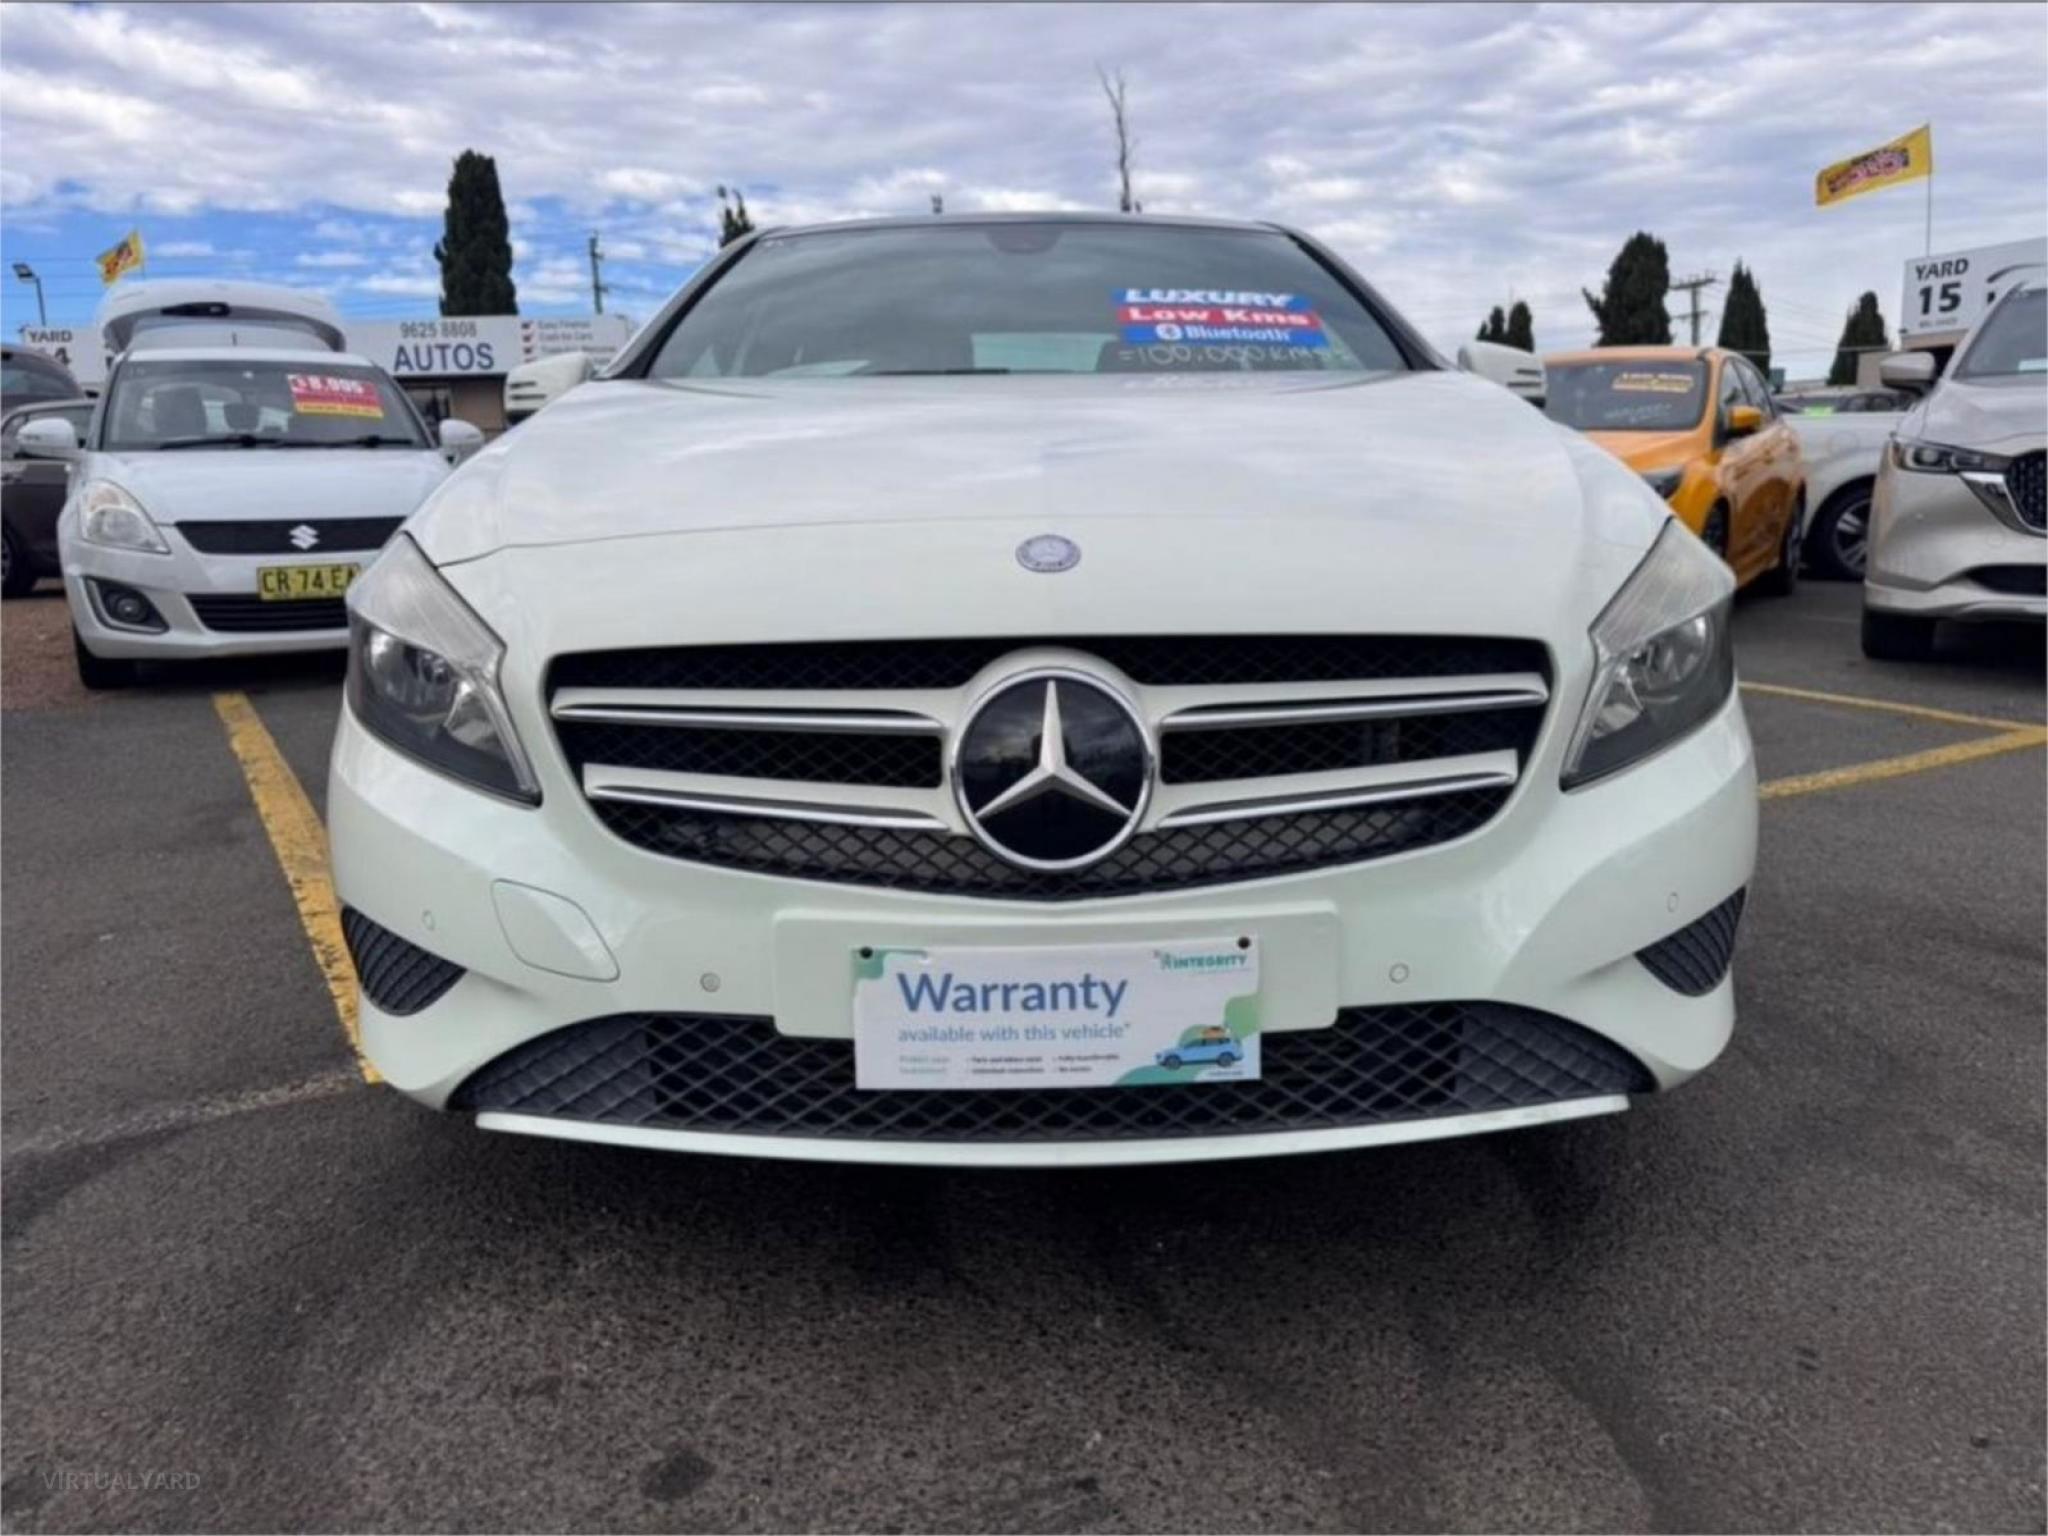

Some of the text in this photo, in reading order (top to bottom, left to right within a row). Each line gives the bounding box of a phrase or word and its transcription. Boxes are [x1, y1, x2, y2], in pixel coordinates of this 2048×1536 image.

[1915, 257, 1969, 279] YARD
[1125, 288, 1293, 306] LUXURY
[1919, 282, 1962, 315] 15
[1129, 308, 1310, 326] Low Kms
[29, 329, 73, 344] YARD
[401, 321, 437, 339] 9625
[1186, 325, 1291, 342] Bluetooth
[394, 341, 495, 372] AUTOS
[262, 569, 292, 594] CR
[297, 569, 325, 591] 74
[896, 971, 1127, 1017] Warranty
[899, 1026, 974, 1043] available
[979, 1025, 1018, 1041] with
[1023, 1024, 1057, 1041] this
